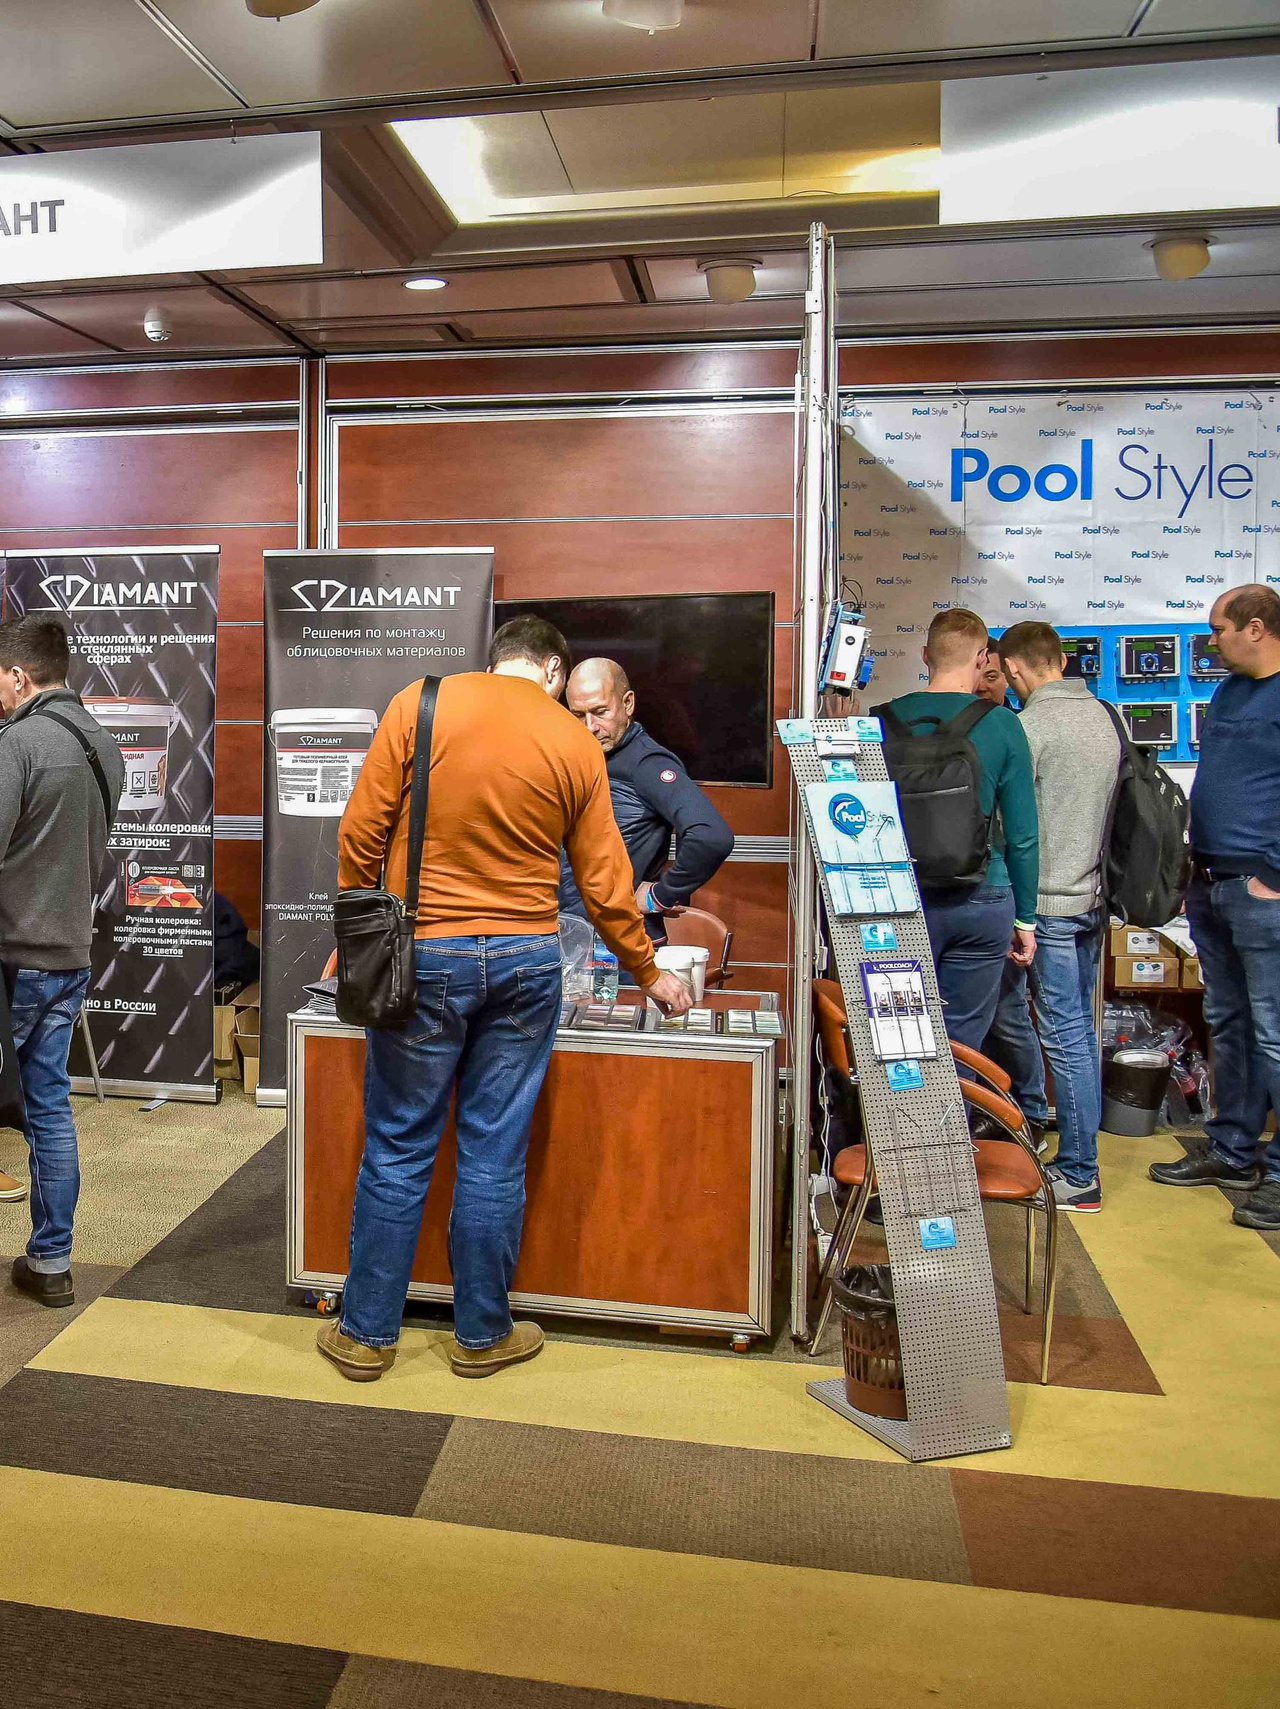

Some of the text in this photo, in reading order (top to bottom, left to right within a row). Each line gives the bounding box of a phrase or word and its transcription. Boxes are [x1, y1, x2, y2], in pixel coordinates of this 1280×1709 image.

[1067, 404, 1104, 413] Pool Style
[1165, 403, 1182, 412] Style
[1224, 401, 1243, 409] Pool
[912, 407, 948, 417] Pool Style
[989, 406, 1026, 415] Pool Style
[961, 431, 998, 440] Pool Style
[1039, 429, 1075, 438] Pool Style
[1117, 427, 1154, 437] Pool Style
[1196, 426, 1234, 436] Pool Style
[885, 432, 921, 441] Pool Style
[1248, 450, 1267, 458] Pool
[859, 457, 894, 466] Pool Style
[951, 439, 1253, 519] Pool Style
[907, 480, 944, 489] Pool Style
[900, 505, 917, 513] Style
[873, 529, 890, 538] Style
[1006, 527, 1042, 537] Pool Style
[1082, 526, 1119, 536] Pool Style
[1183, 526, 1201, 536] Style
[1243, 525, 1262, 533] Pool
[847, 554, 863, 562] Style
[922, 553, 938, 561] Style
[998, 552, 1015, 561] Style
[1055, 551, 1092, 560] Pool Style
[1151, 551, 1169, 560] Style
[1214, 550, 1252, 560] Pool Style
[876, 577, 912, 586] Pool Style
[951, 576, 987, 585] Pool Style
[1028, 576, 1064, 585] Pool Style
[1104, 575, 1142, 585] Pool Style
[1186, 575, 1224, 585] Pool Style
[932, 601, 950, 609] Pool
[1029, 601, 1046, 610] Style
[1087, 600, 1125, 610] Pool Style
[1166, 600, 1204, 610] Pool Style
[896, 625, 914, 633] Pool
[303, 627, 445, 641] Решения по монтажу
[76, 635, 146, 644] технологии
[150, 635, 157, 643] и
[161, 634, 215, 646] решения
[80, 645, 153, 654] стеклянных
[287, 645, 466, 659] облицовочных материалов
[869, 649, 906, 658] Pool Style
[87, 654, 131, 665] сферах
[149, 823, 211, 834] колеровки
[120, 838, 170, 848] затирок:
[309, 892, 328, 900] Клей
[265, 904, 334, 912] эпоксидно-полиур
[126, 915, 201, 926] Ручная колеровка:
[279, 913, 313, 921] DIAMANT
[114, 926, 212, 936] колеровка фирменными
[113, 936, 212, 946] колеровочными пастами
[143, 946, 153, 954] 30
[115, 999, 156, 1012] России
